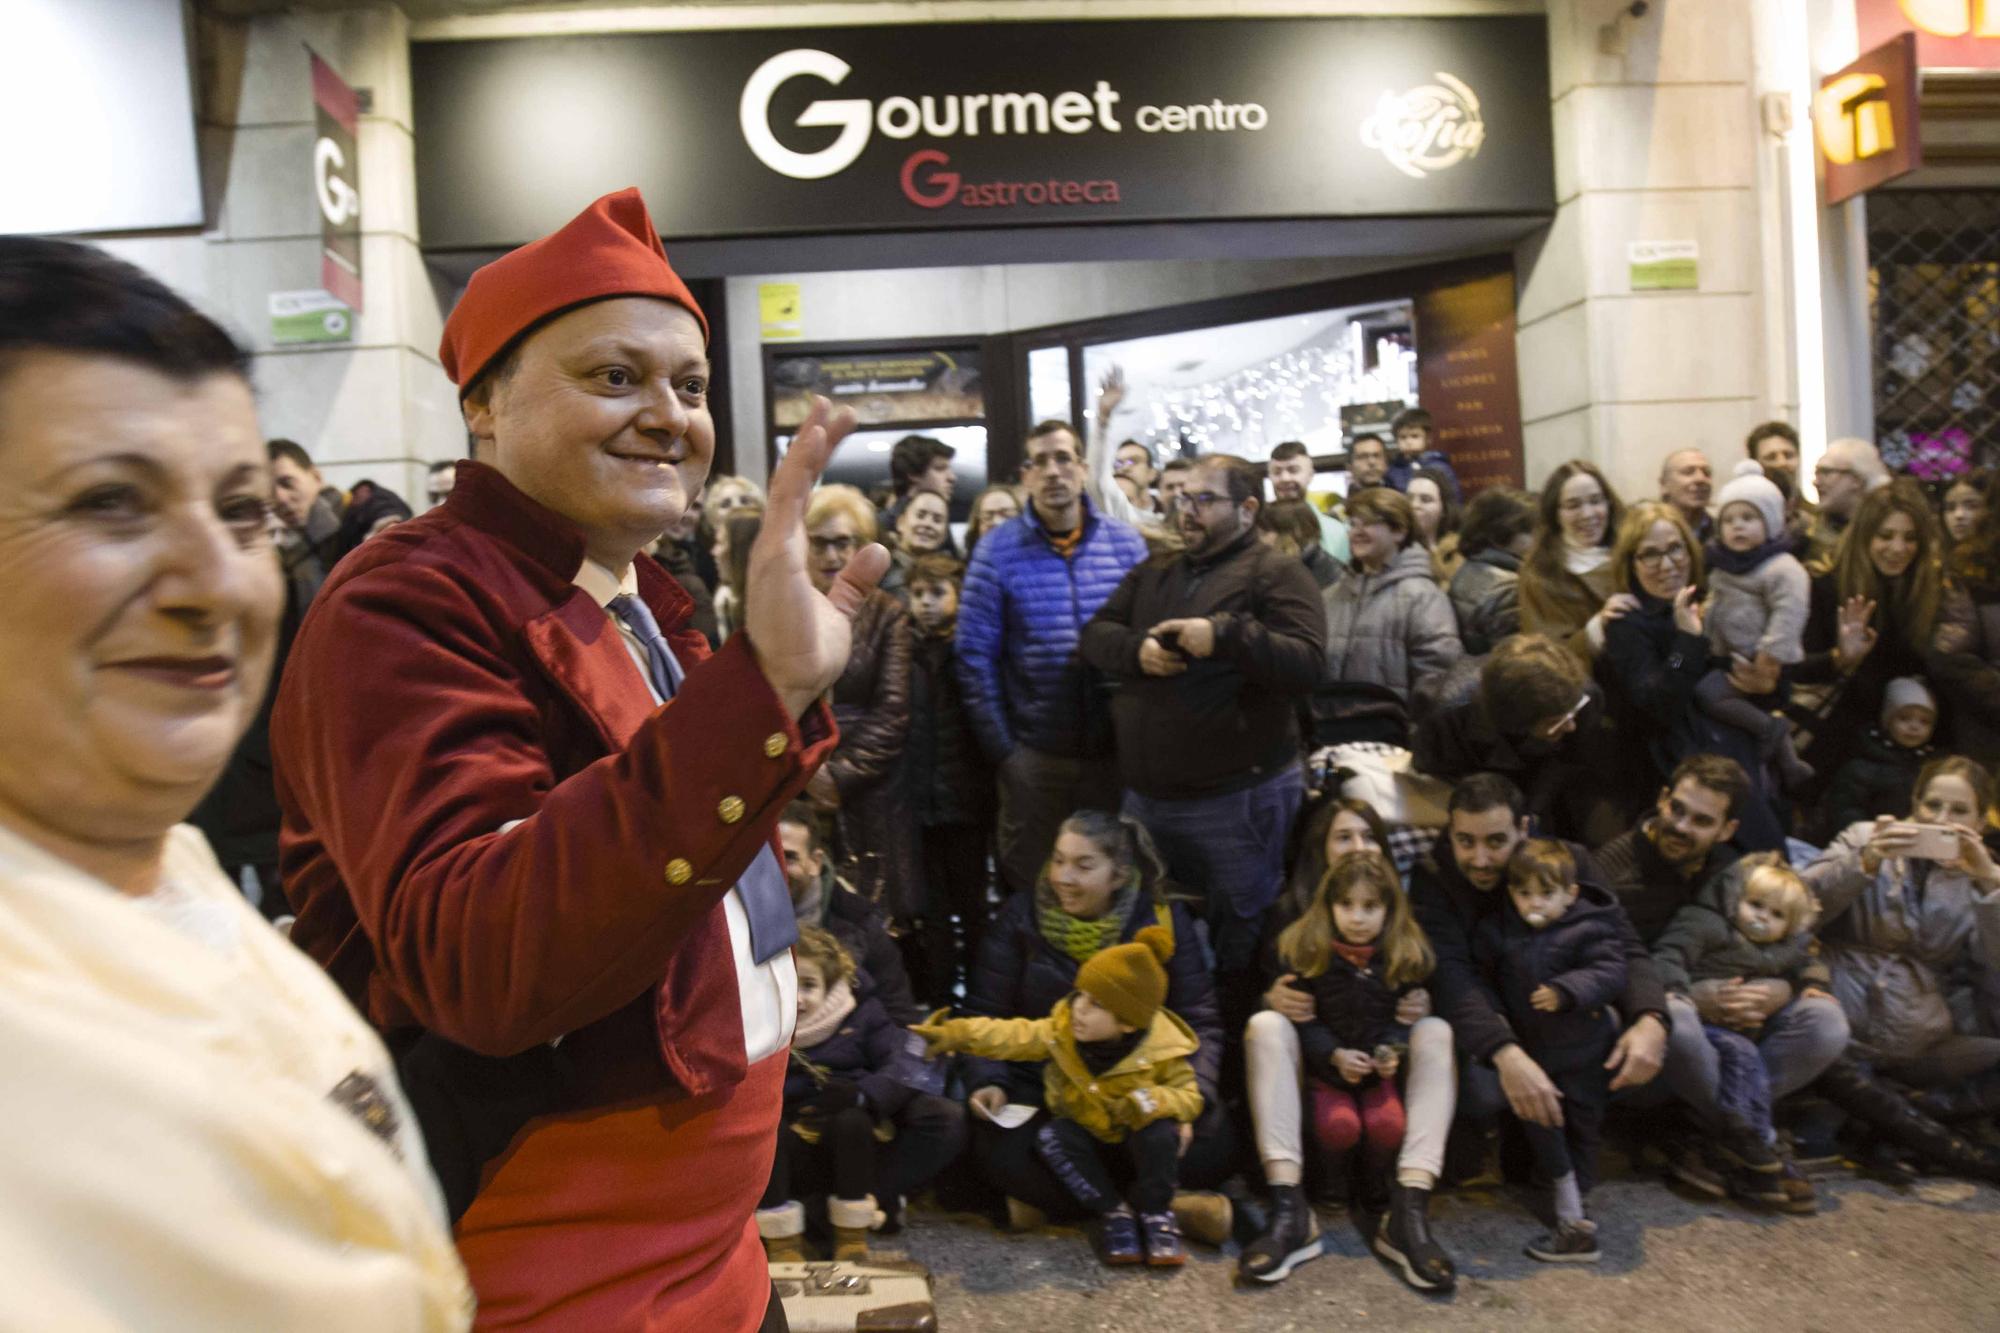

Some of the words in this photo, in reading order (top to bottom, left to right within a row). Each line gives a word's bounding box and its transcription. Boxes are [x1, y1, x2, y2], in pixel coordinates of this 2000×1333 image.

[740, 48, 1121, 179] Gourmet
[1135, 98, 1268, 133] centro
[901, 149, 1120, 208] Gastroteca
